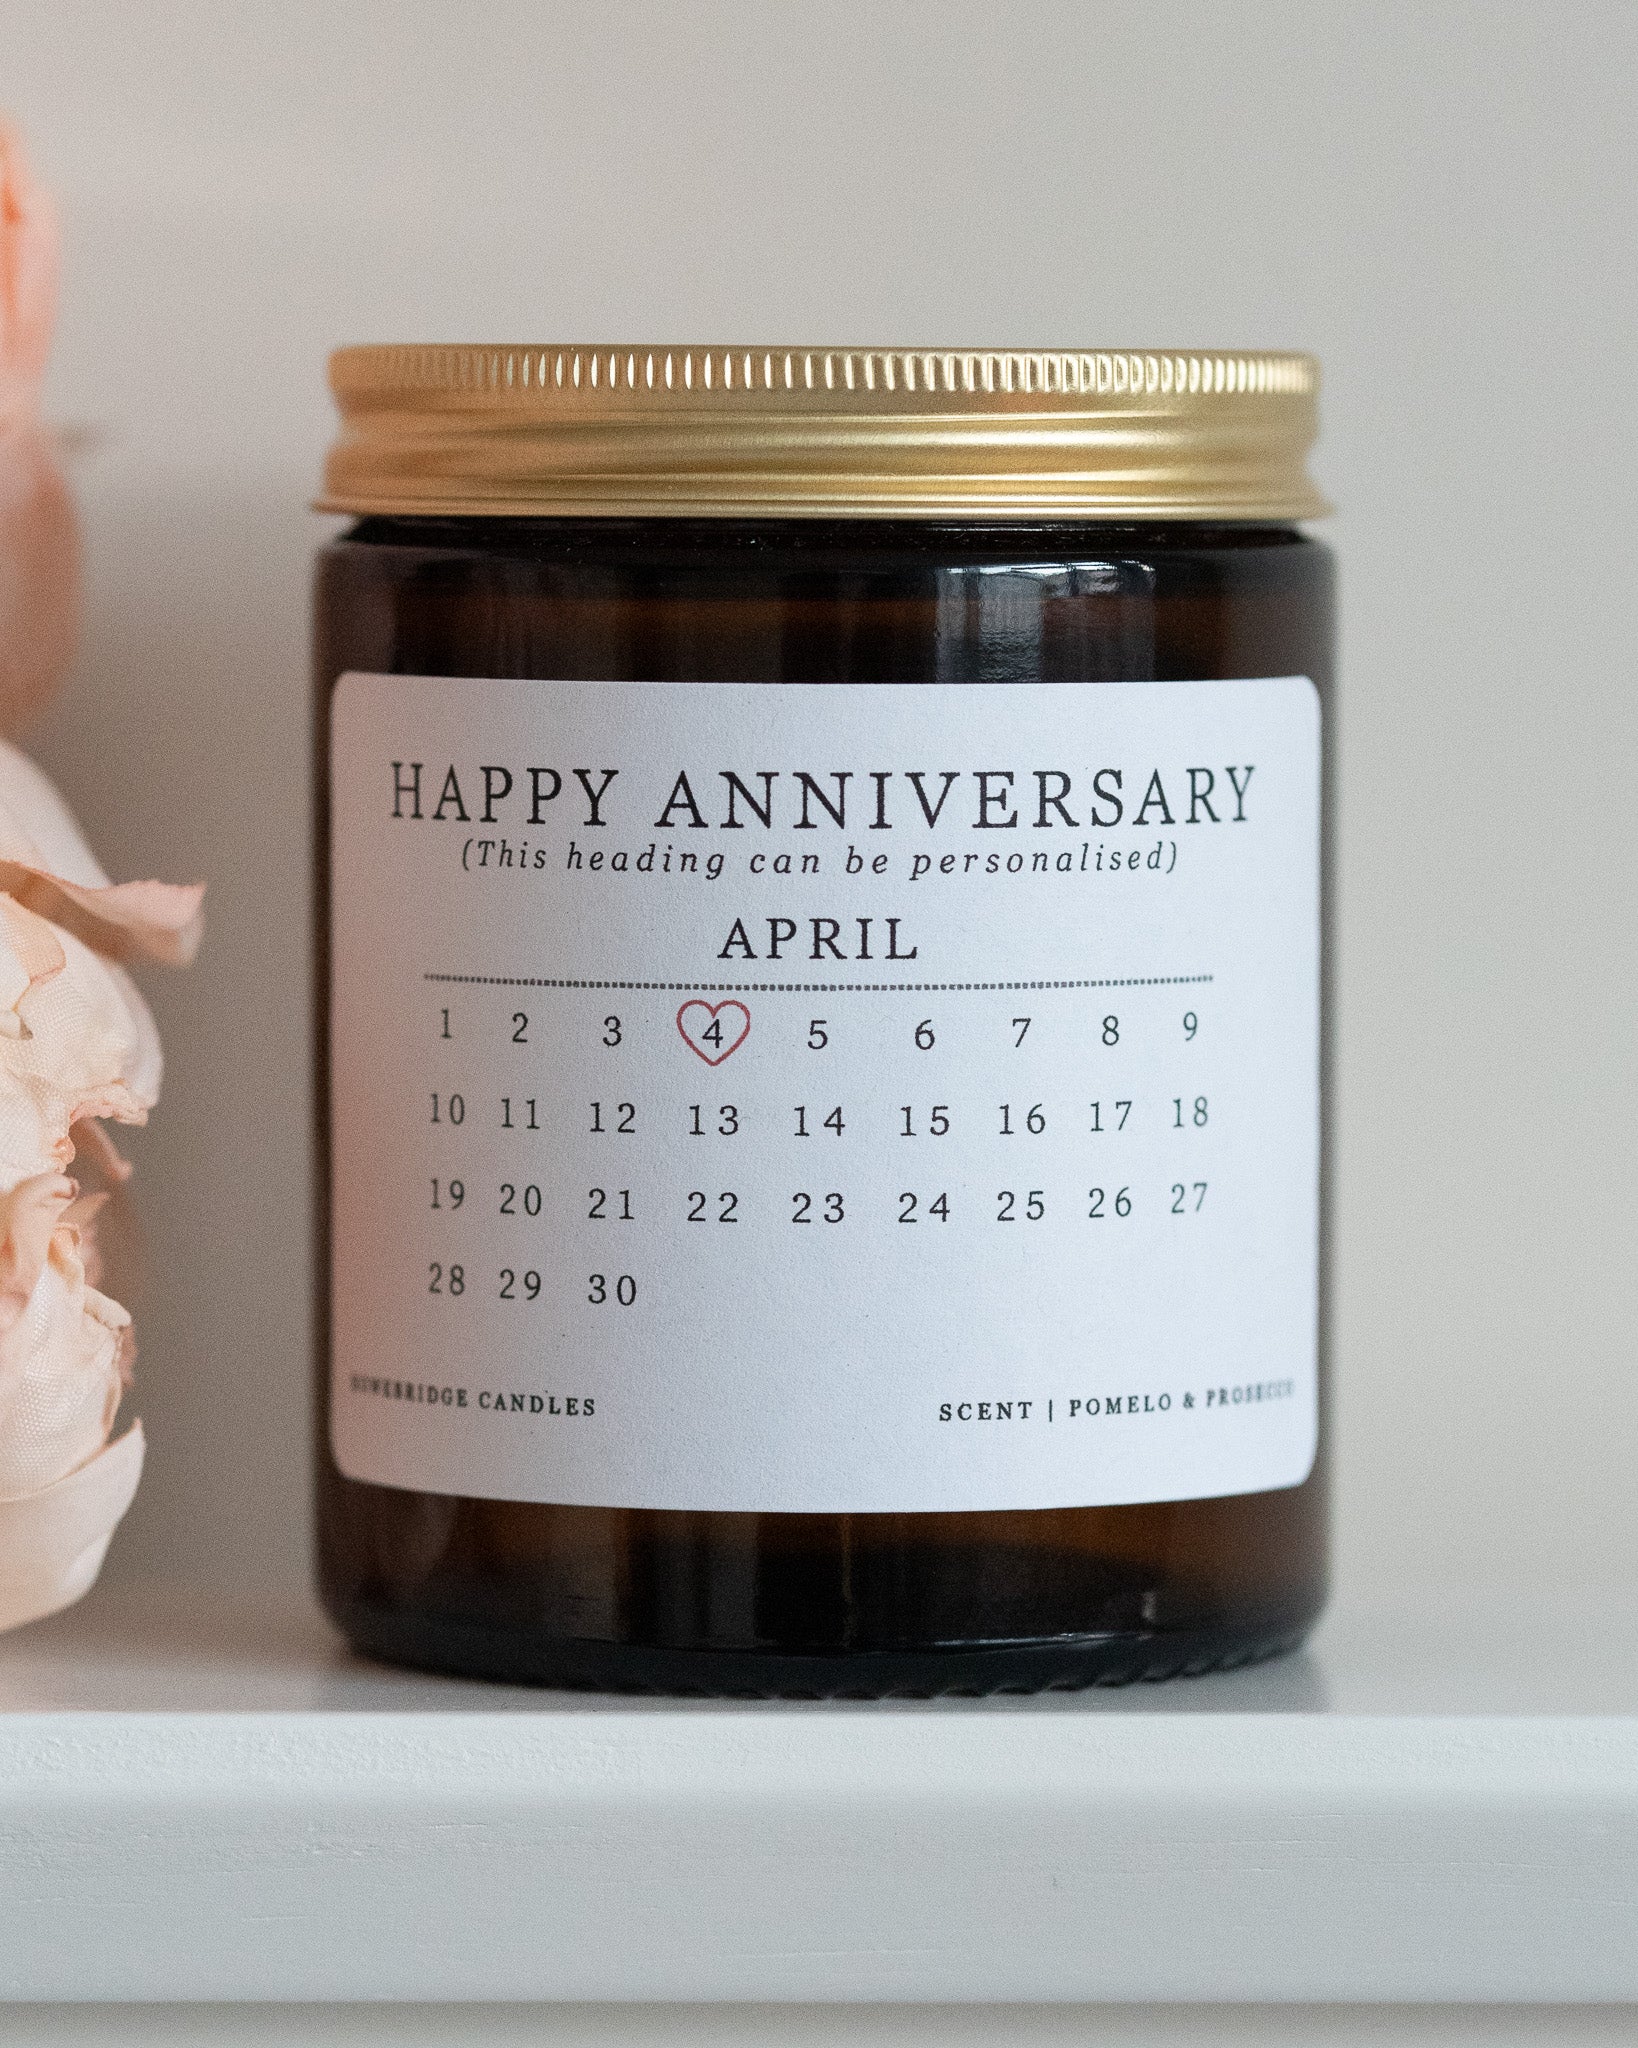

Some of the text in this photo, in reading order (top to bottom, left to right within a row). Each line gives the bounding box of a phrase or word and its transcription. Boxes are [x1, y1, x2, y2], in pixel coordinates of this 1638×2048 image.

[390, 761, 1256, 831] HAPPY ANNIVERSARY
[461, 838, 1178, 882] (This heading can be personalised)
[716, 916, 919, 961] APRIL
[440, 1008, 1199, 1052] 1 2 3 4 5 6 7 8 9
[431, 1093, 1209, 1138] 10 11 12 13 14 15 16 17 18
[431, 1178, 1208, 1225] 19 20 21 22 23 24 25 26 27
[428, 1262, 638, 1307] 28 29 30
[478, 1391, 596, 1417] CANDLES
[938, 1400, 1034, 1423] SCENT
[1068, 1392, 1172, 1418] POMELO
[1182, 1391, 1196, 1408] &
